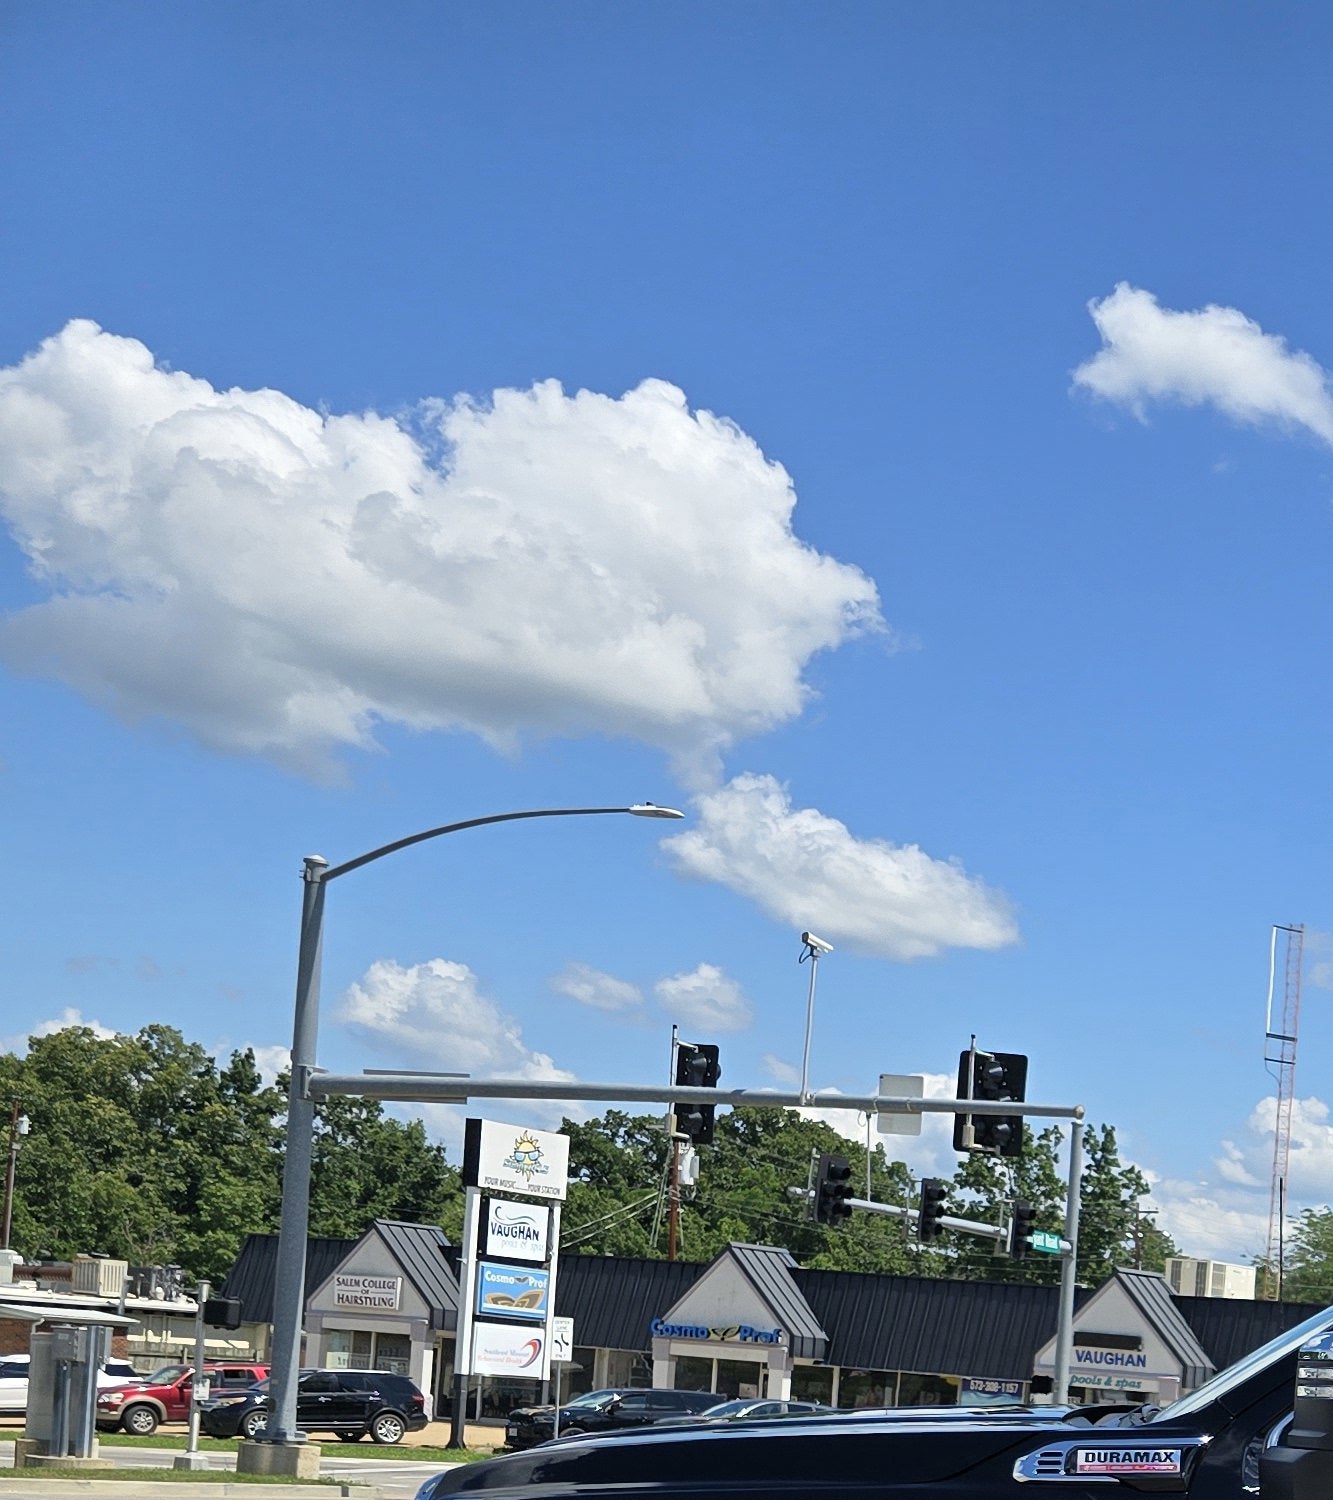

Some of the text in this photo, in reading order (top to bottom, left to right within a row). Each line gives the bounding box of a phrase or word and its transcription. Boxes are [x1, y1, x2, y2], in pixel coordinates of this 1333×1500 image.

[490, 1222, 540, 1241] VAUGHAN
[336, 1276, 396, 1290] SALEM COLLEGE
[484, 1270, 548, 1289] Cosmo Prof
[337, 1293, 394, 1308] HAIRSTYLING
[650, 1319, 783, 1344] Cosmo Prof
[1075, 1349, 1147, 1368] VAUGHAN
[1069, 1374, 1143, 1389] pools & spas
[1084, 1451, 1175, 1463] DURAMAX
